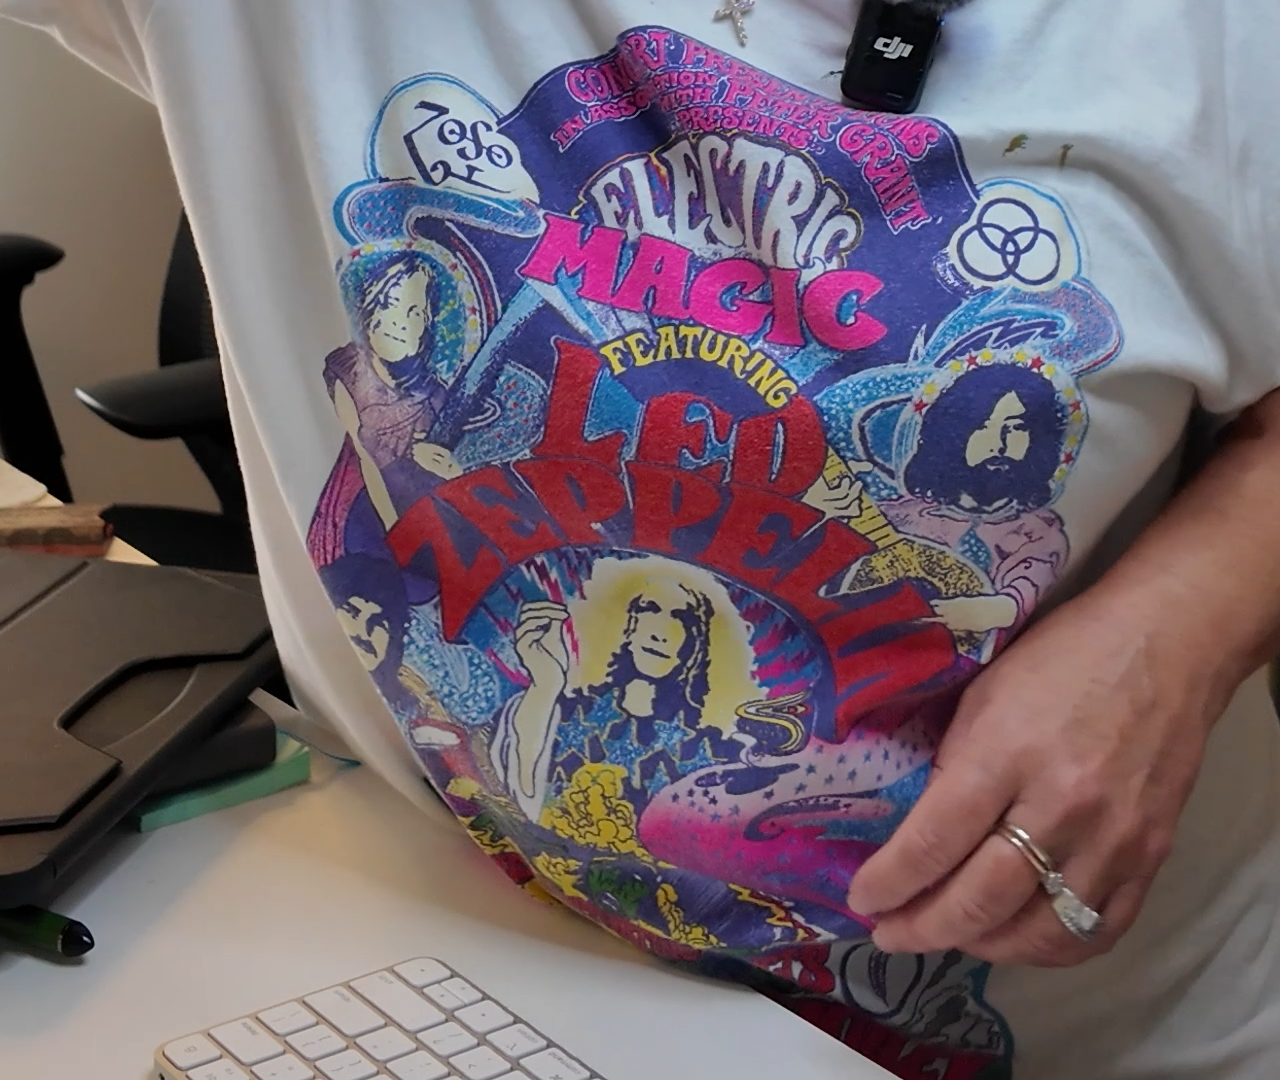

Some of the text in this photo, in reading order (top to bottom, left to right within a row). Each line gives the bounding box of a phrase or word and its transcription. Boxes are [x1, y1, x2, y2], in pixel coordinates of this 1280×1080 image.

[553, 70, 718, 148] IN ASSOTION
[566, 30, 670, 104] CONRT
[590, 134, 862, 282] ELECTRIC
[724, 75, 838, 139] PETER
[837, 123, 930, 232] GRANT
[520, 214, 888, 351] MAGIC
[531, 338, 827, 497] LED
[599, 324, 800, 409] FEATURING
[385, 457, 959, 744] ZEPPELIN
